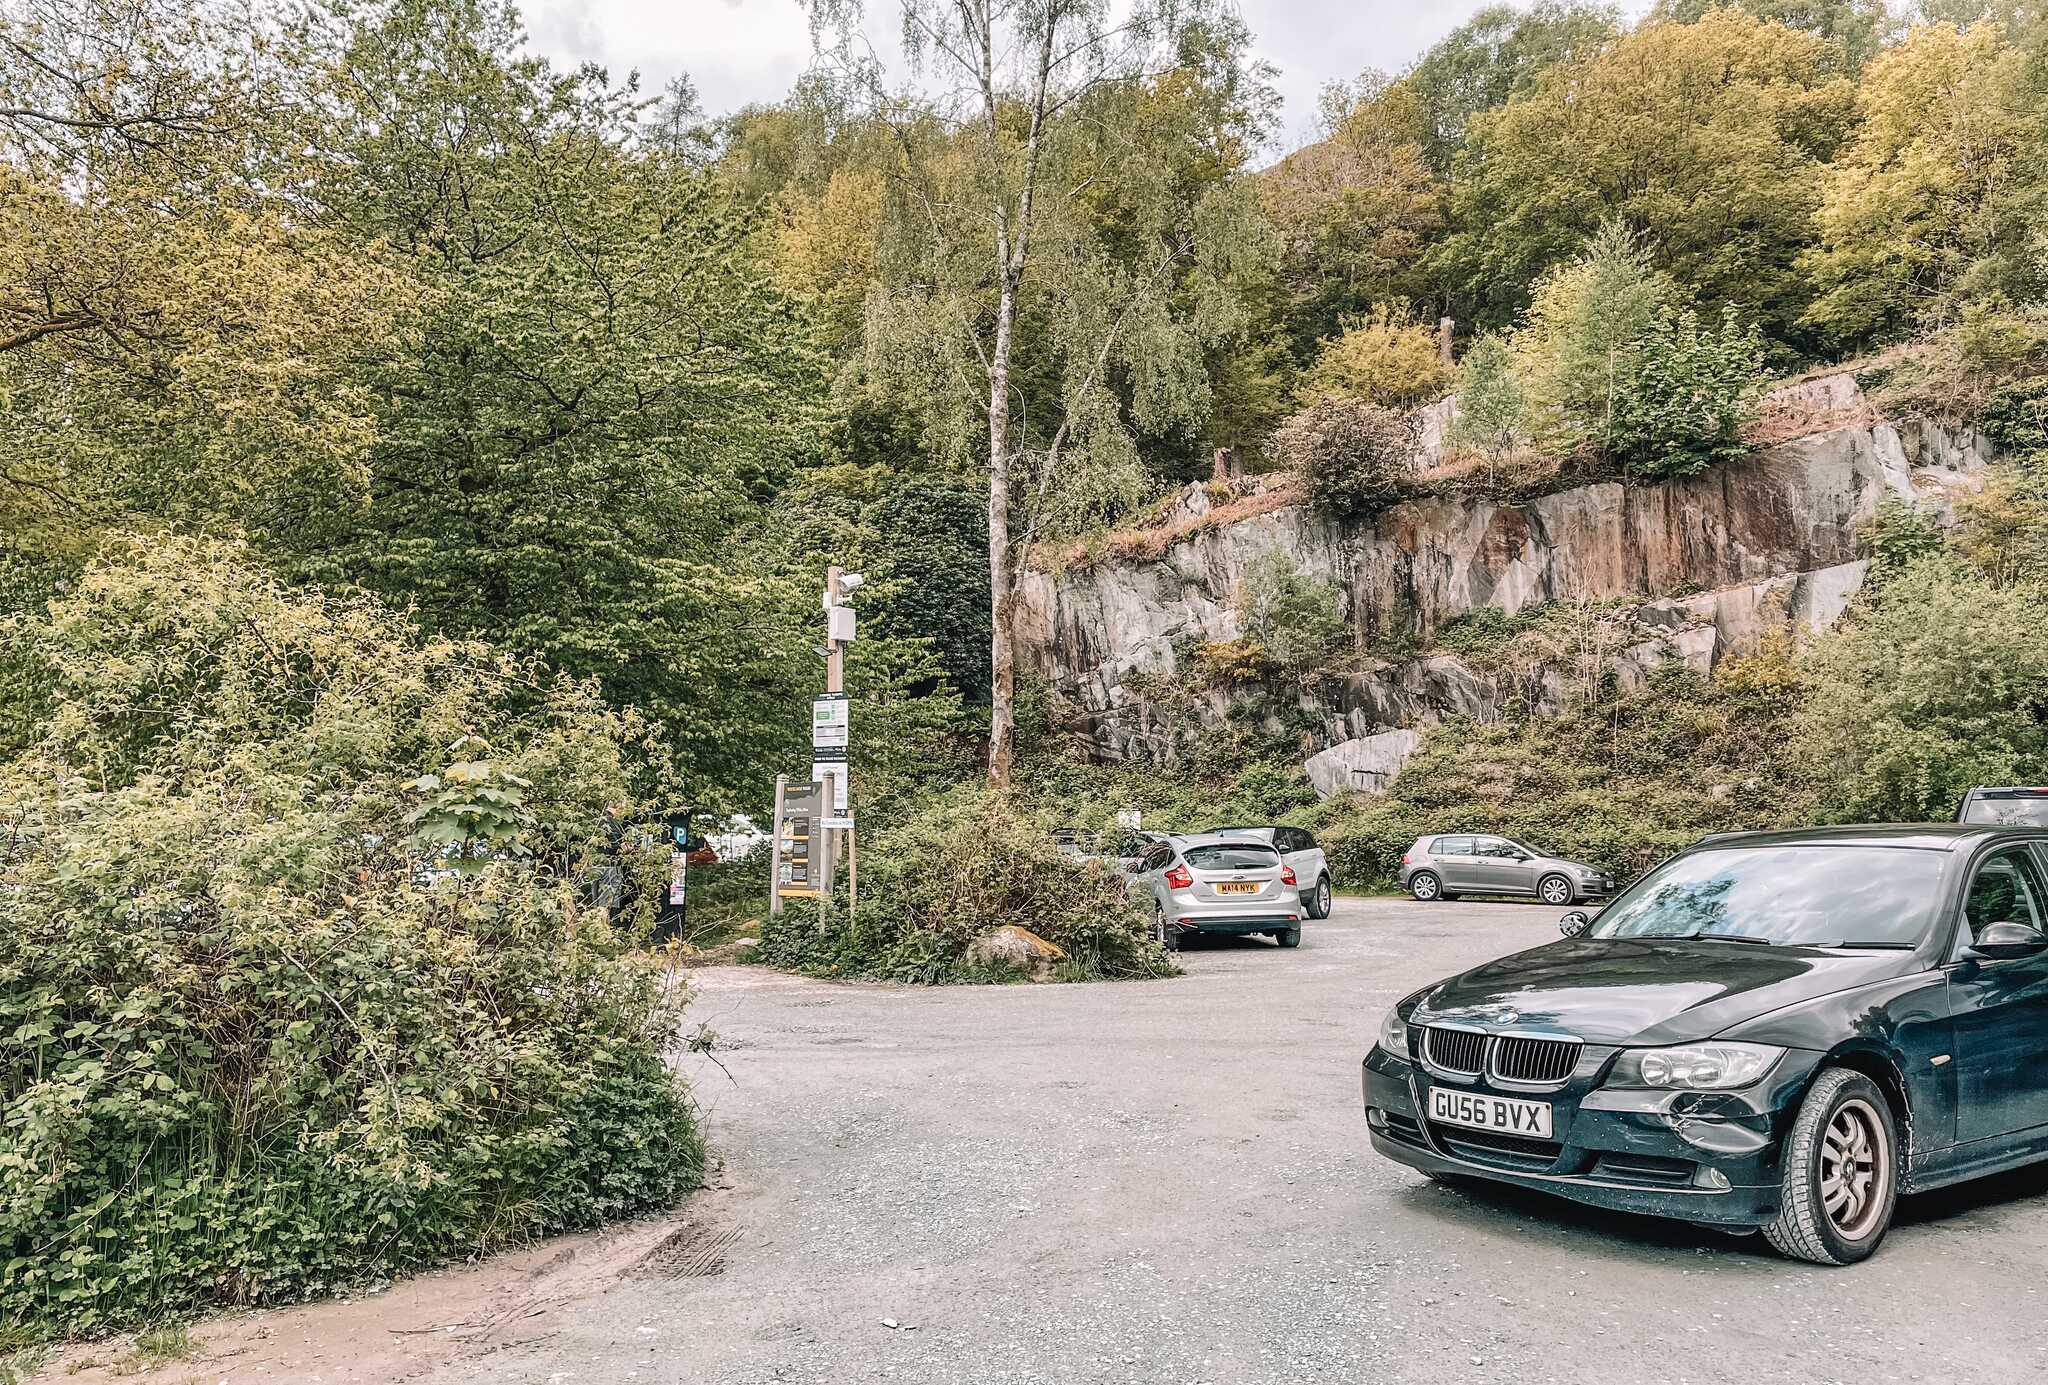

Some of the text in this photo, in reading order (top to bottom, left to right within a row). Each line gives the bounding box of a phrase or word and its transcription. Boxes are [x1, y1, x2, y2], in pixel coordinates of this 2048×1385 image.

[677, 827, 685, 841] P
[1240, 884, 1255, 892] NYK
[1436, 1092, 1540, 1132] GU56 BVX
